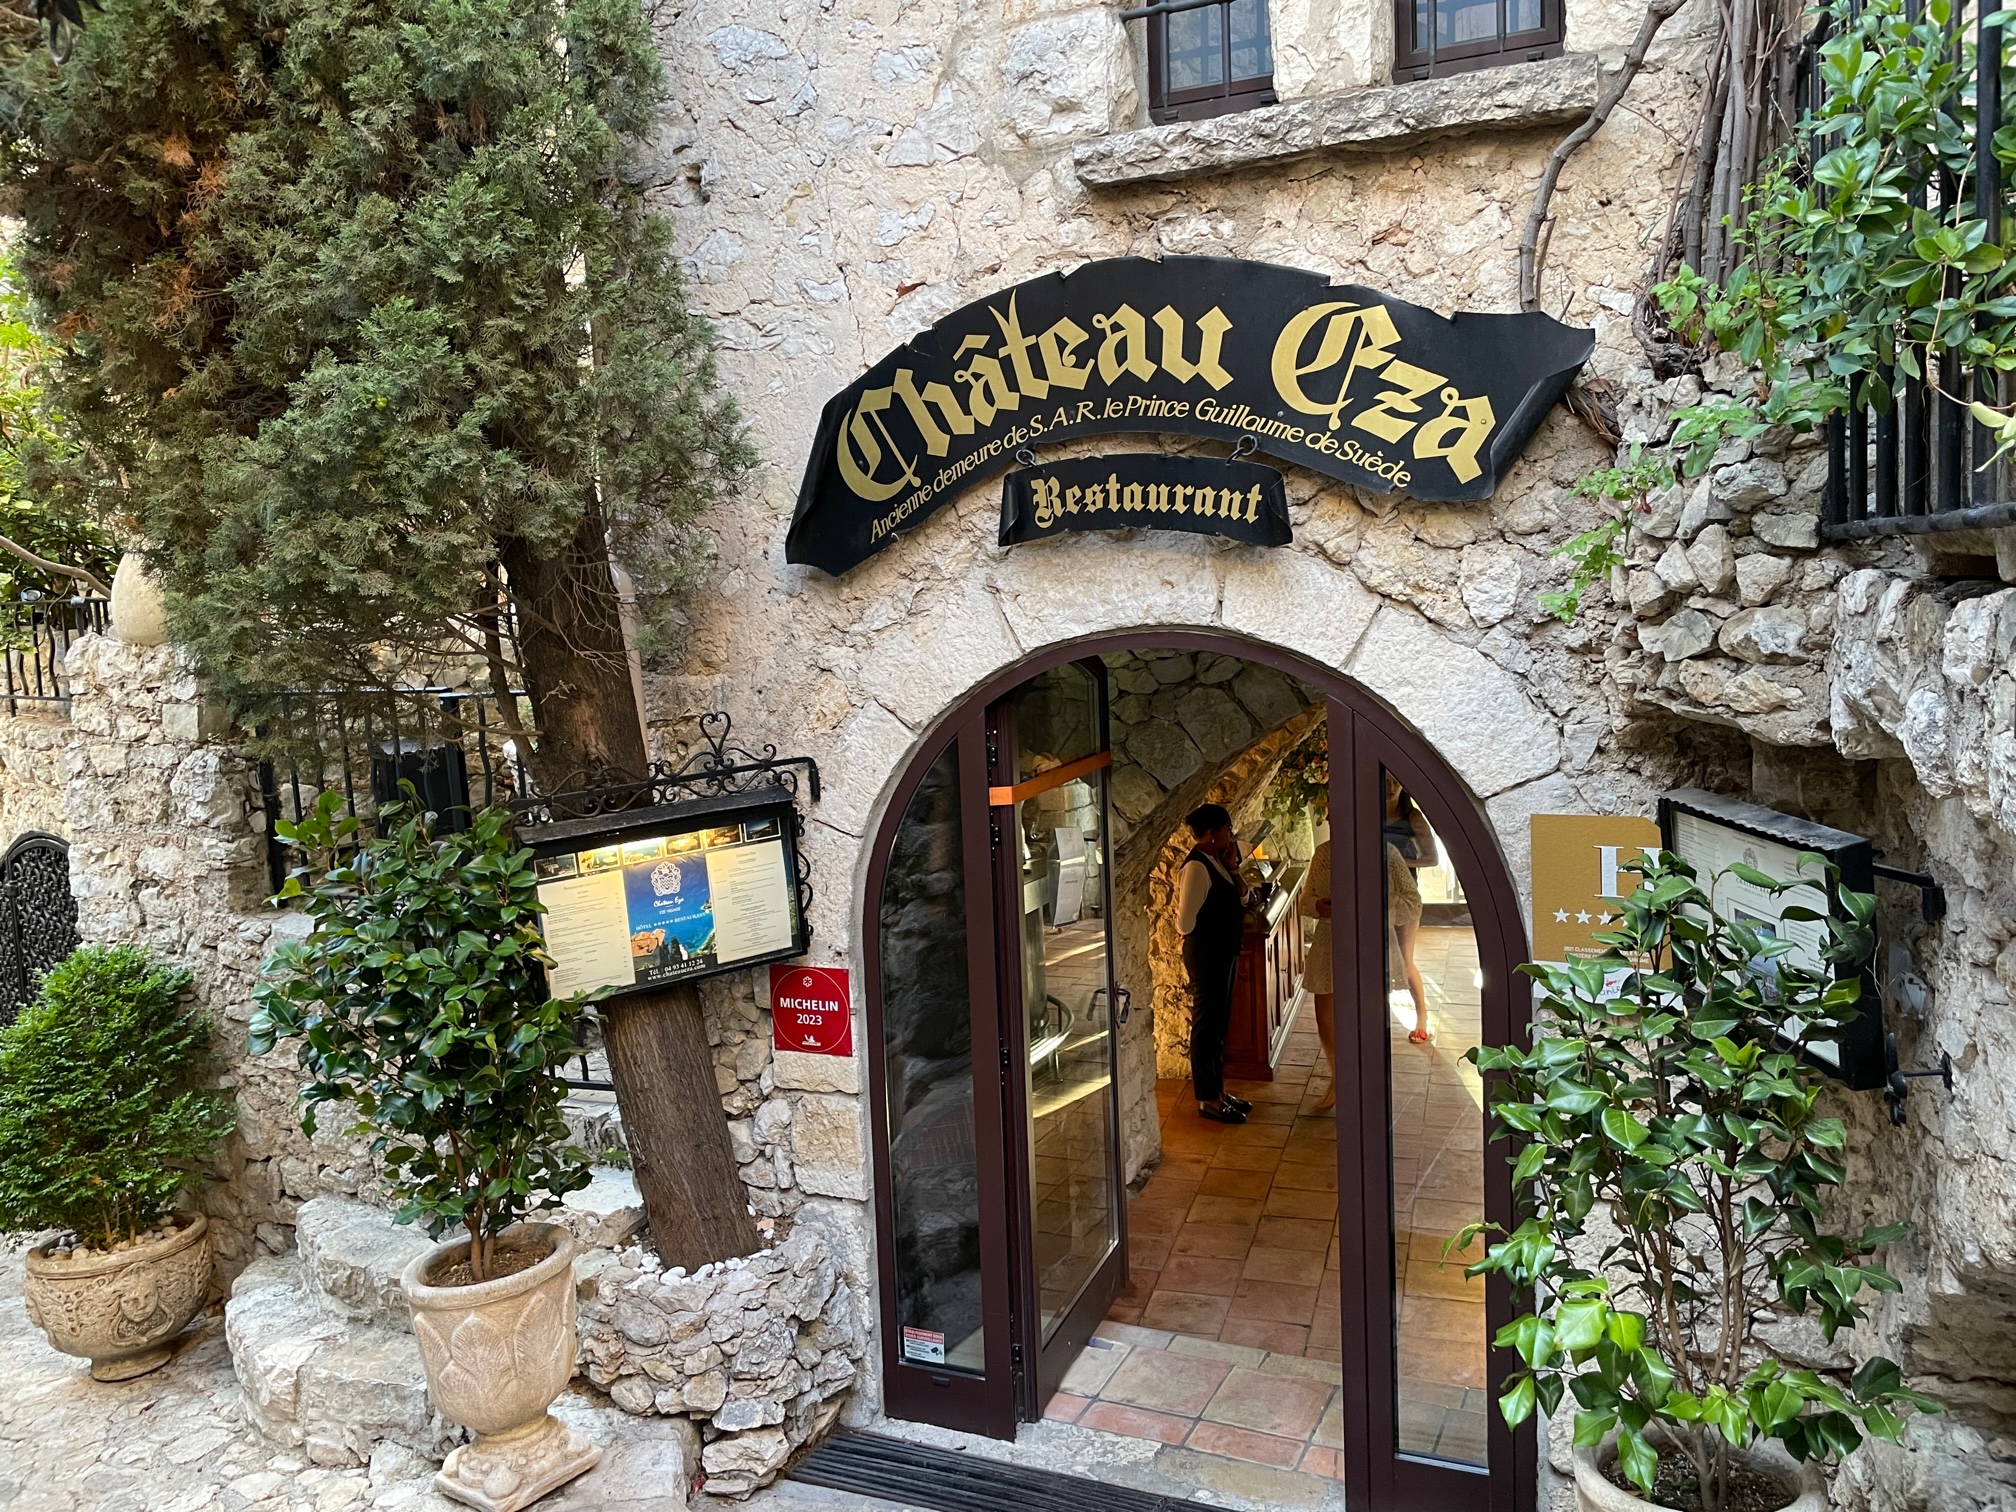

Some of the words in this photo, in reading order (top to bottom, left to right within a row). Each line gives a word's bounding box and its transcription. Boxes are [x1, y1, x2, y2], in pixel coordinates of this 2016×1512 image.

[837, 288, 1233, 501] Château
[1271, 301, 1496, 484] Eza
[870, 484, 933, 545] Ancienne
[933, 439, 1002, 493] demeure
[1003, 426, 1029, 449] de
[1103, 398, 1123, 418] le
[1125, 395, 1189, 417] Prince
[1195, 398, 1305, 443] Guillaume
[1305, 431, 1338, 454] de
[1334, 440, 1412, 488] Suède
[1030, 473, 1263, 529] Restaurant
[780, 997, 838, 1012] MICHELIN
[796, 1013, 822, 1026] 2023
